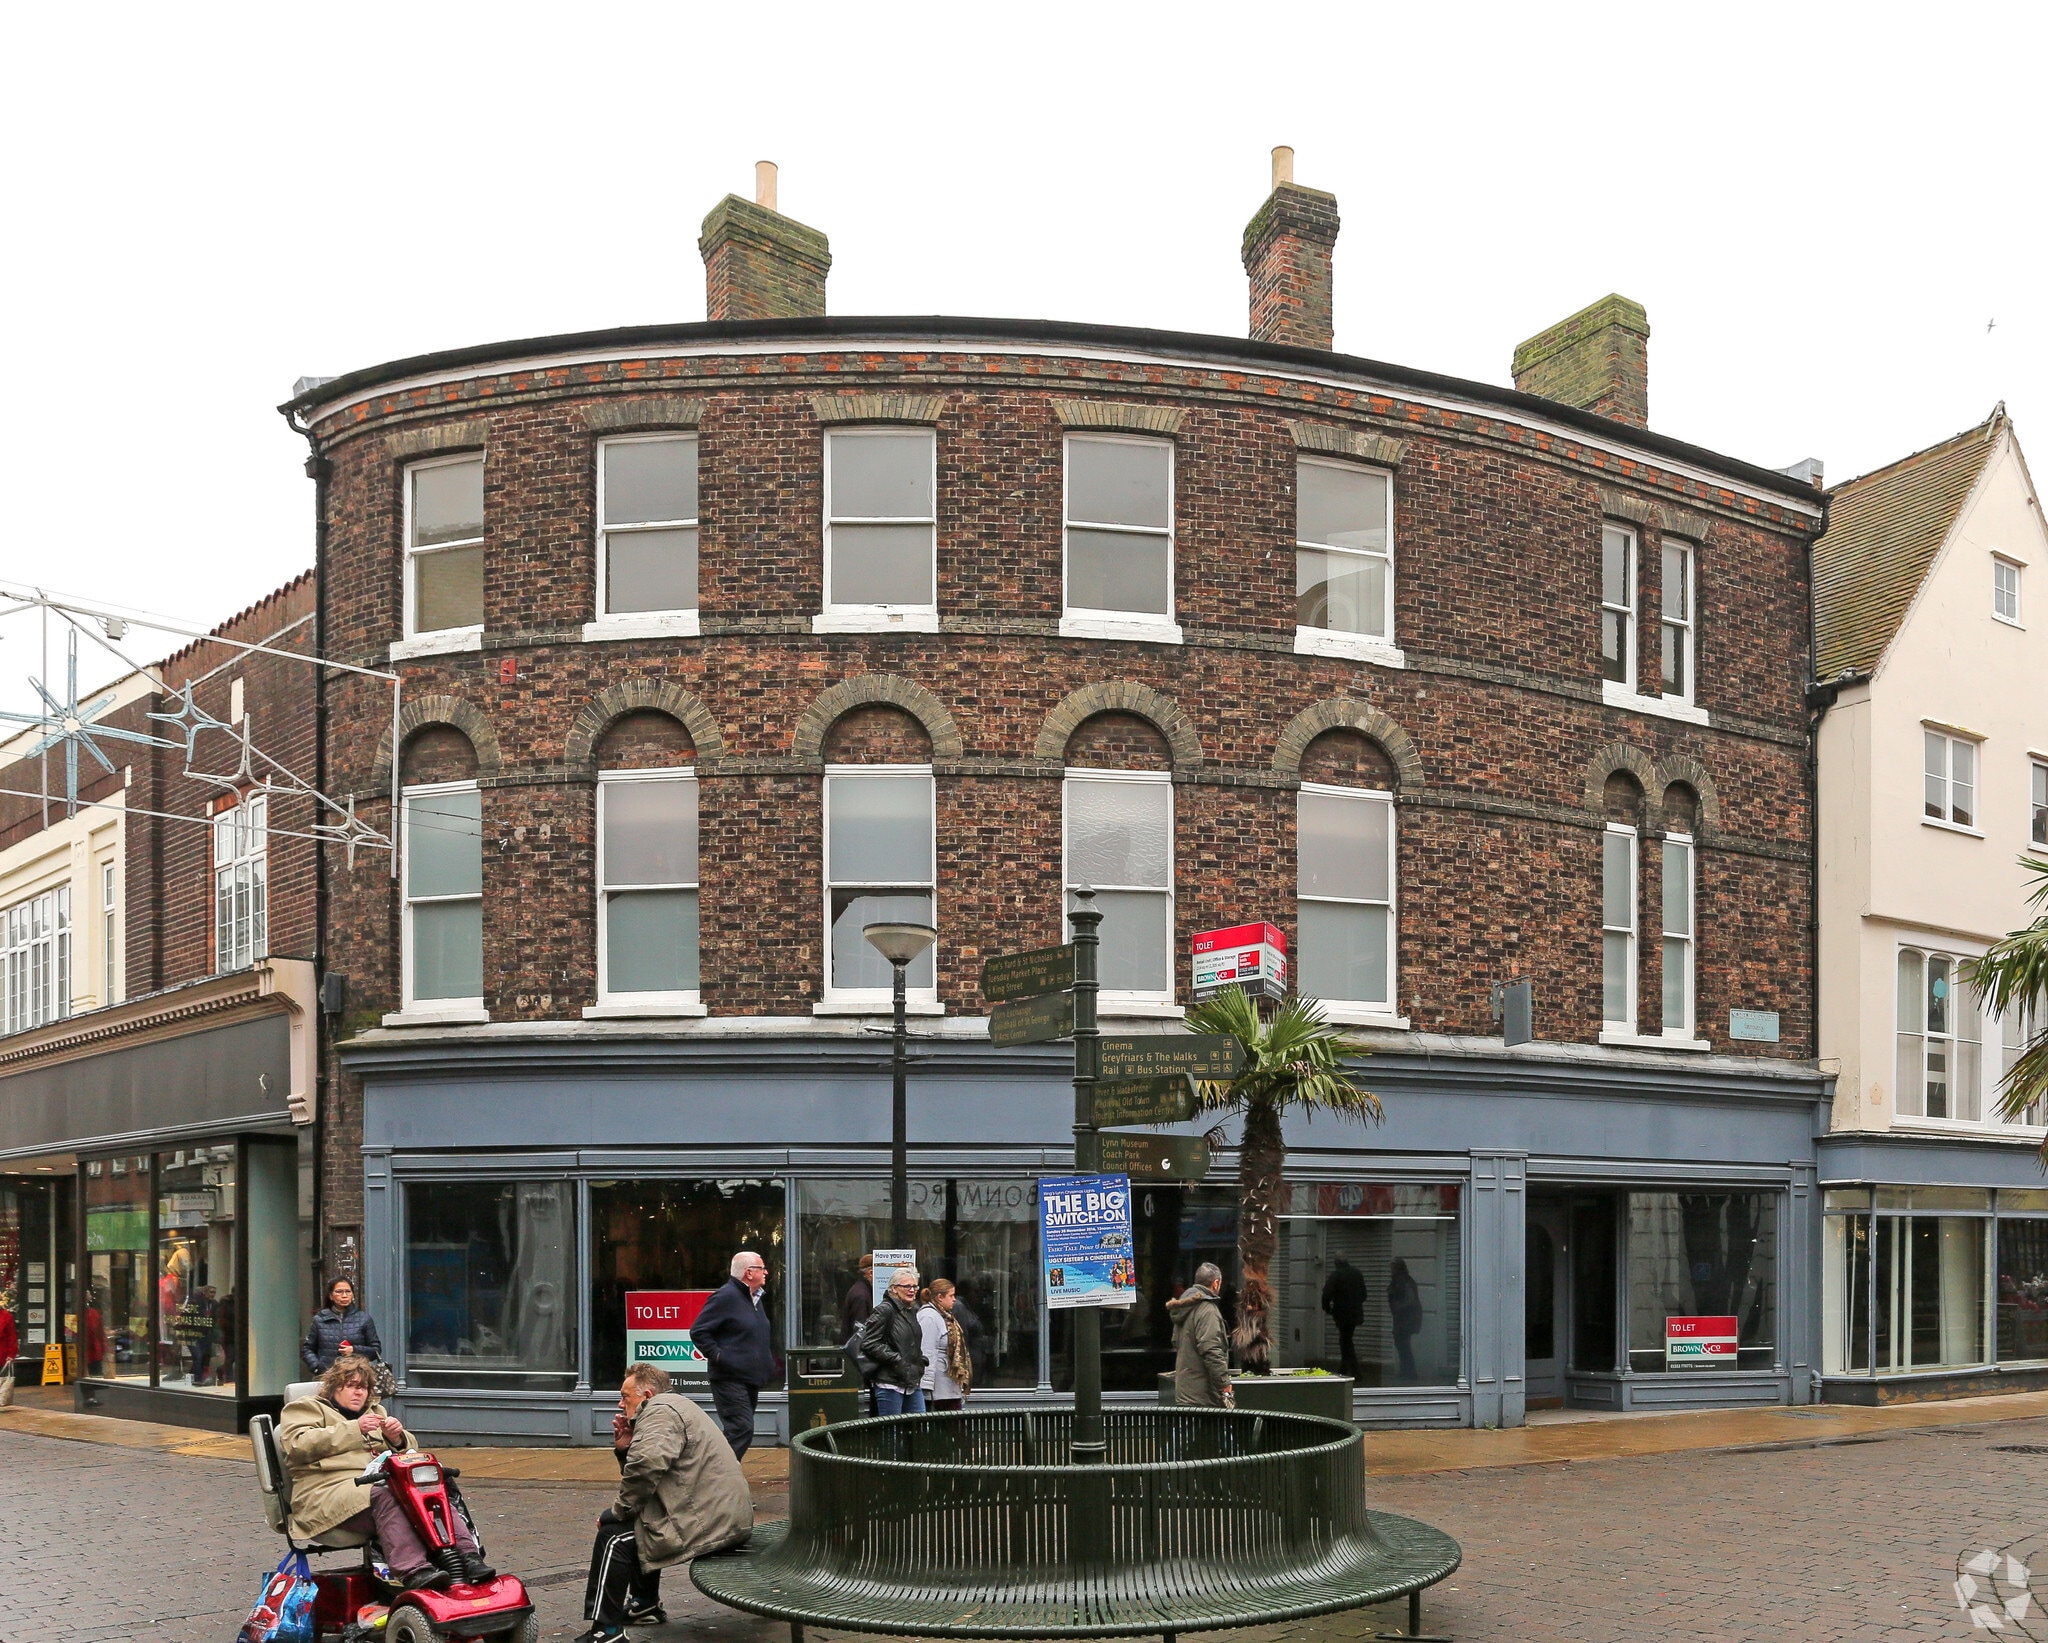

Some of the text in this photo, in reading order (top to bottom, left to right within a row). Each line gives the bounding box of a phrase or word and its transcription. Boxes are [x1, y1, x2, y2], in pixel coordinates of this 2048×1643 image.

[1204, 940, 1214, 949] LET
[1022, 957, 1028, 966] St
[1029, 953, 1053, 965] Nicholas
[987, 966, 1048, 984] Tuesday Market Place
[992, 984, 1005, 995] King
[1006, 982, 1023, 992] Street
[1018, 1019, 1024, 1027] of
[1102, 1041, 1133, 1051] Cinema
[1102, 1052, 1198, 1063] Greyfriars & The Walks
[1102, 1064, 1186, 1074] Rail Bus Station
[1122, 1097, 1133, 1106] Old
[1134, 1096, 1150, 1105] Town
[1095, 1106, 1174, 1121] Tourist Information Centre
[1102, 1138, 1149, 1148] Lynn Museum
[1102, 1150, 1140, 1159] Coach Park
[1102, 1161, 1153, 1172] Council Offices
[1043, 1191, 1125, 1214] THE BIG
[1045, 1208, 1126, 1226] SWITCH-ON
[1090, 1253, 1123, 1261] CINDERELLA
[635, 1306, 680, 1319] TO LET
[1671, 1324, 1696, 1332] TO LET
[808, 1378, 833, 1386] Litter
